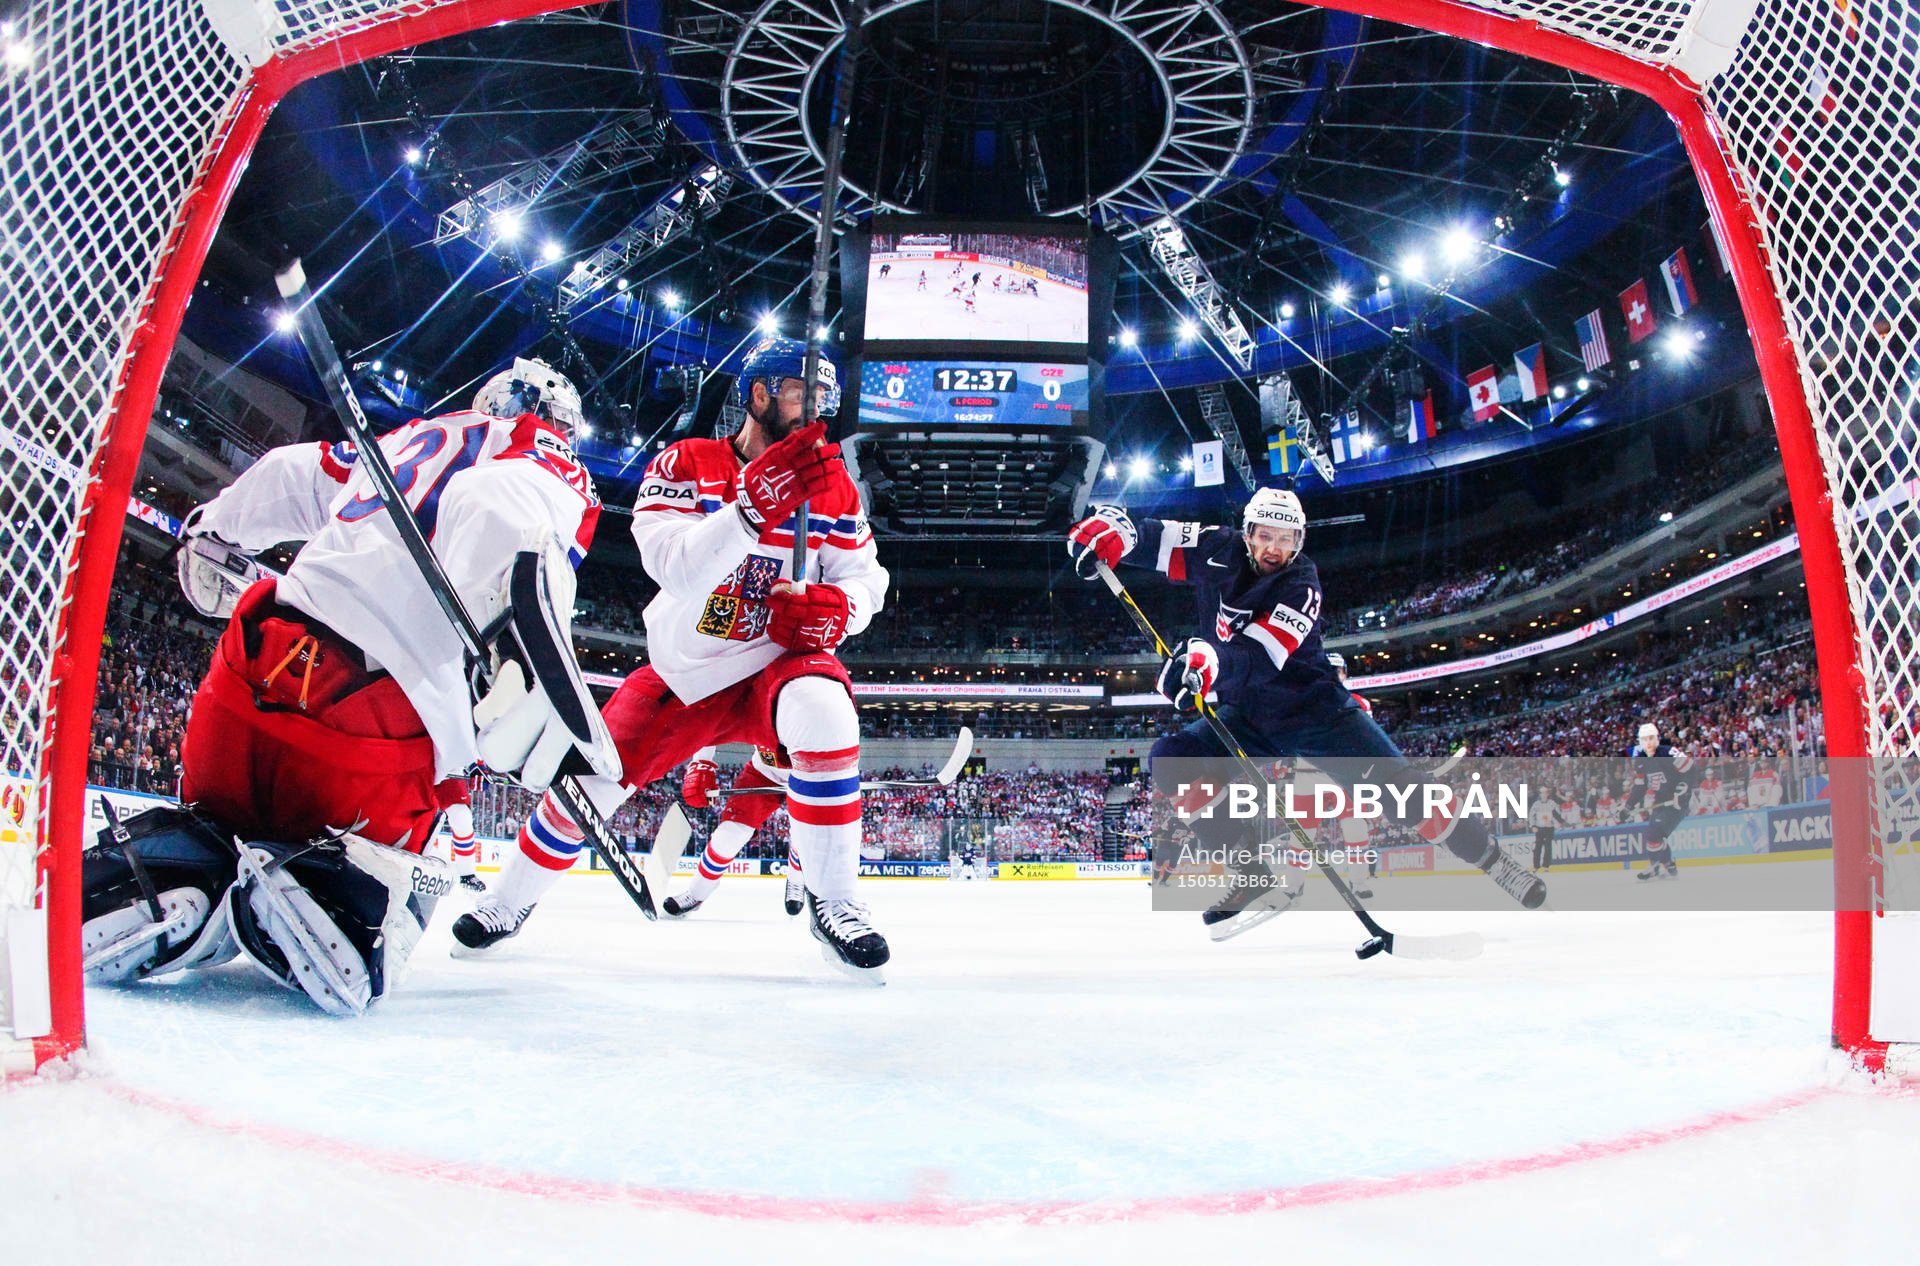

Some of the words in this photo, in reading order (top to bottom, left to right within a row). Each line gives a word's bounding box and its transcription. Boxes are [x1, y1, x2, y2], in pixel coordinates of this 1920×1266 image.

[1041, 368, 1064, 377] CZE
[887, 377, 905, 399] 0
[938, 370, 1012, 391] 12:37
[1043, 380, 1061, 401] 0
[963, 398, 993, 406] PERIOD
[639, 485, 695, 500] KODA
[1301, 587, 1321, 621] 13
[1273, 609, 1308, 636] ŠKO
[953, 686, 1006, 694] Championship
[1773, 815, 1832, 842] XACK
[1552, 838, 1599, 859] NIVEA
[1600, 832, 1643, 857] MEN
[678, 860, 698, 869] ŠKOD
[727, 862, 750, 874] IHF
[883, 865, 914, 875] MEN
[1096, 863, 1137, 871] TISSOT
